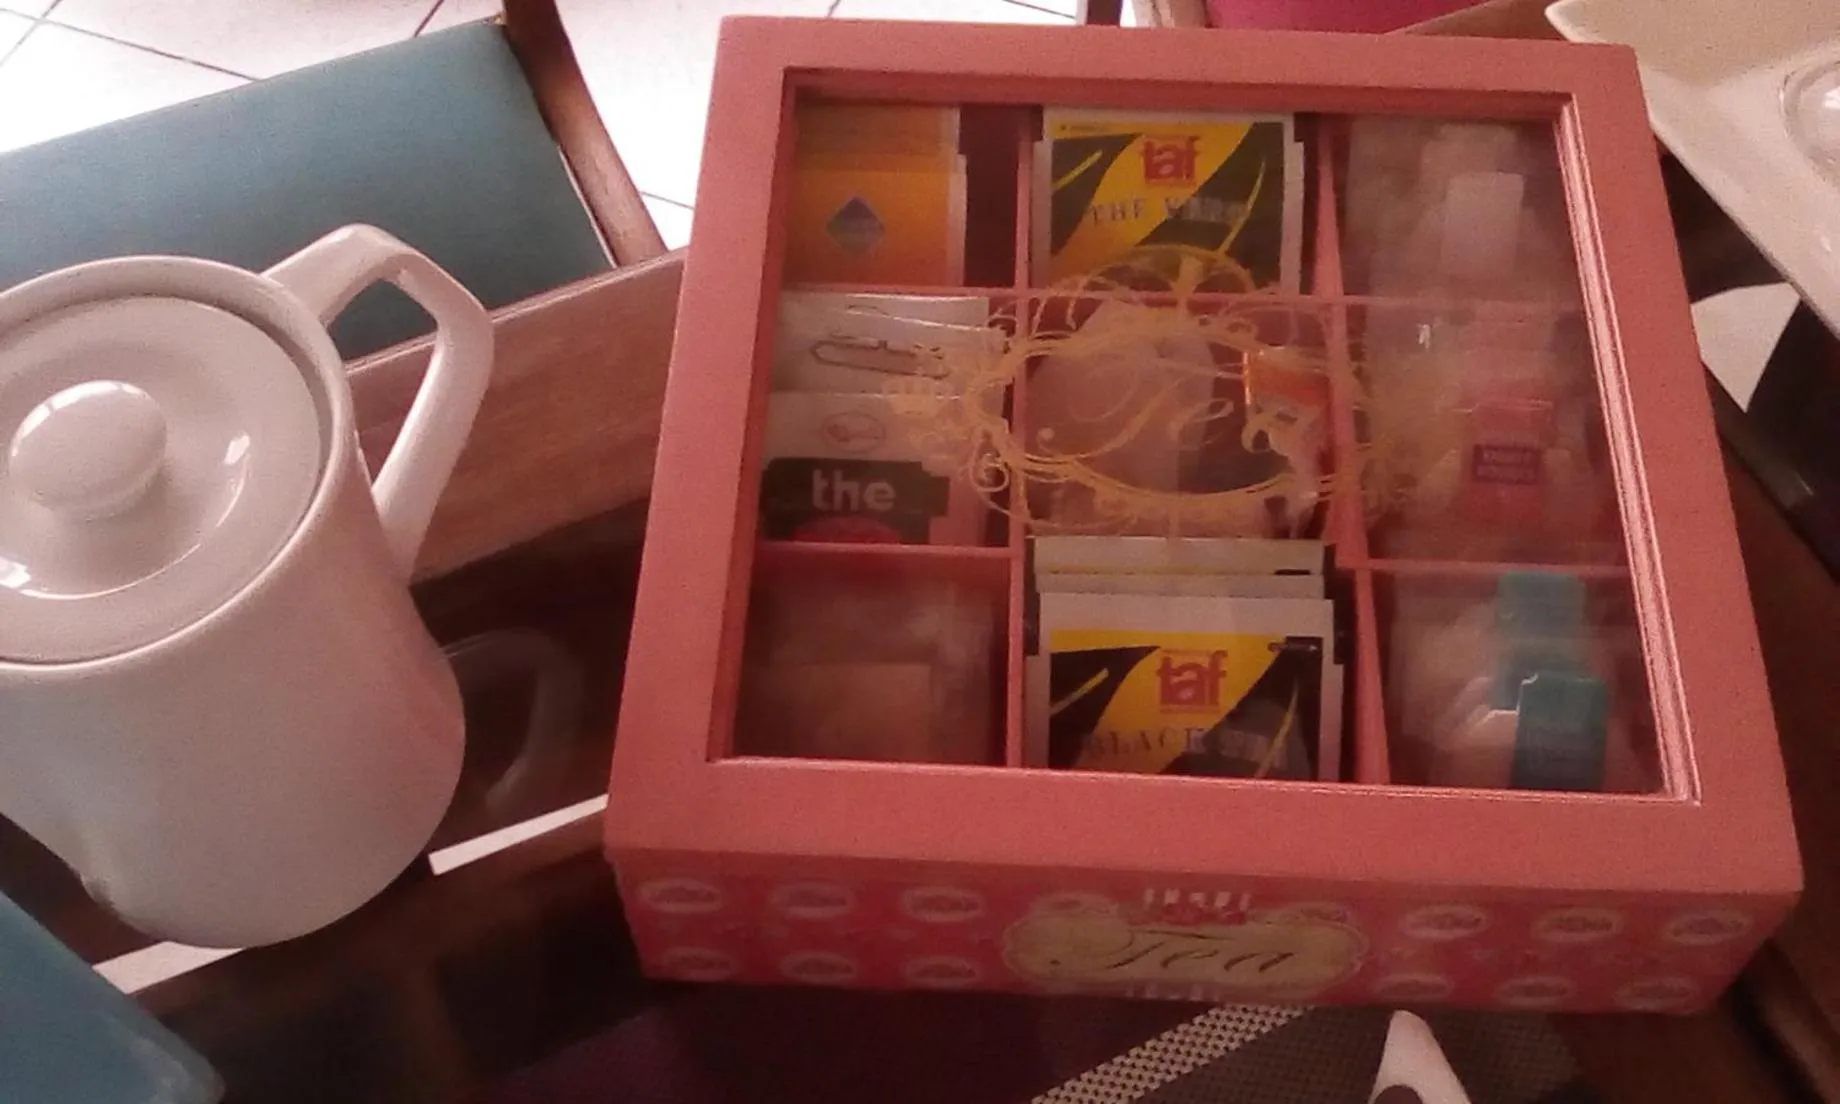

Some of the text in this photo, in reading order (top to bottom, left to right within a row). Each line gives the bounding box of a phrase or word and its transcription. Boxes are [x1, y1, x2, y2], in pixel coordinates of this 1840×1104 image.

[1143, 135, 1200, 182] taf
[812, 468, 897, 513] the
[1157, 650, 1229, 706] taf
